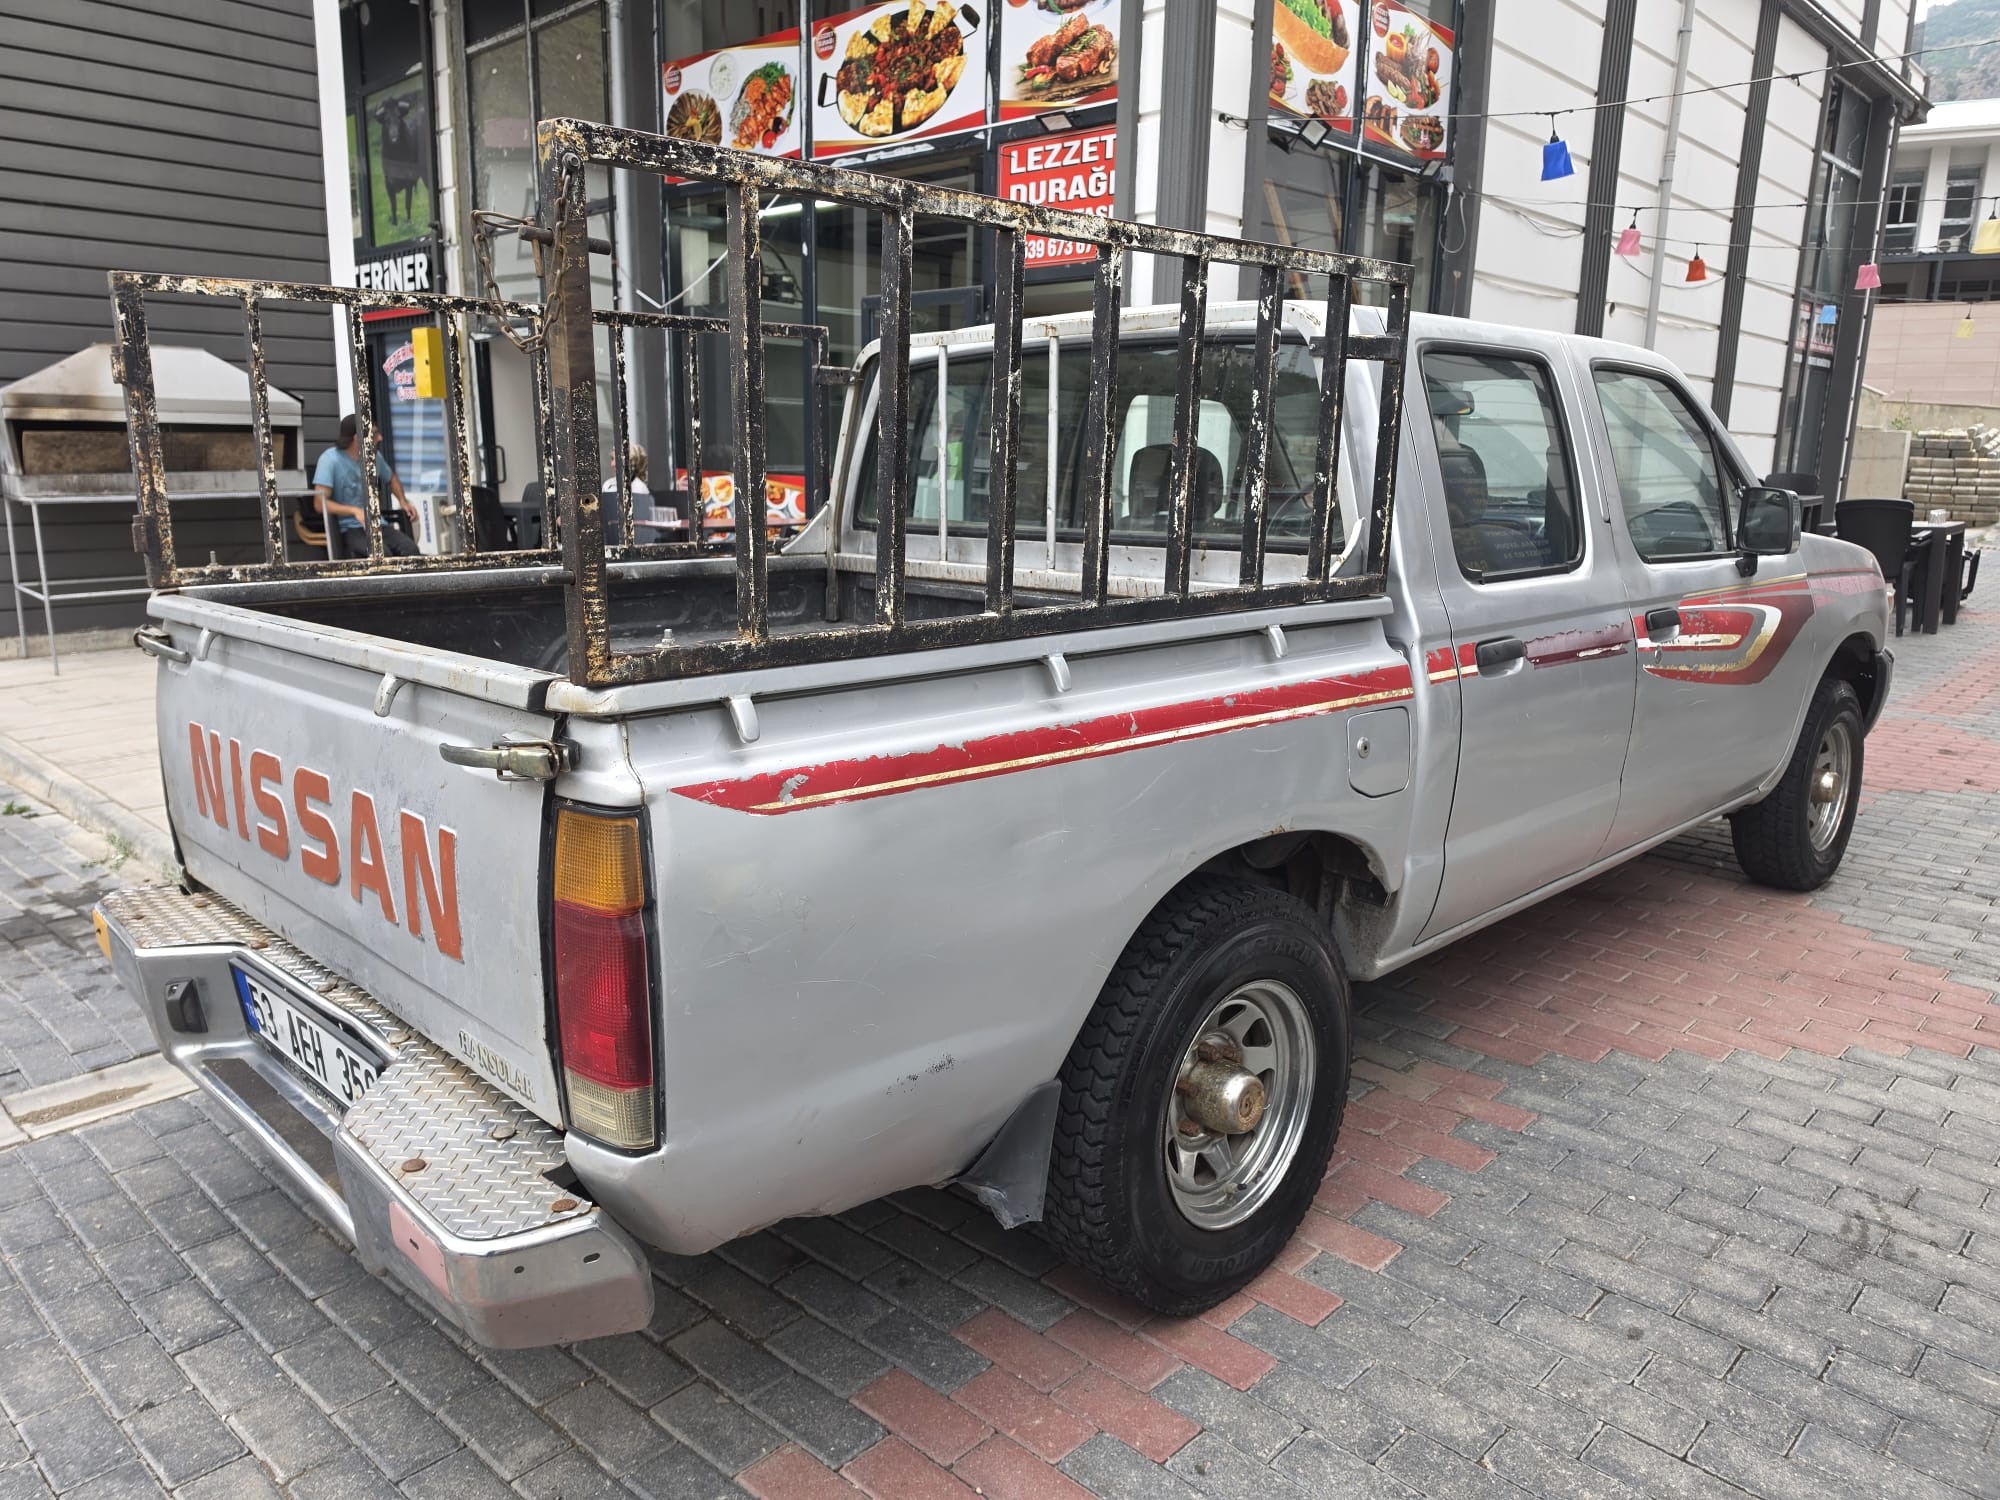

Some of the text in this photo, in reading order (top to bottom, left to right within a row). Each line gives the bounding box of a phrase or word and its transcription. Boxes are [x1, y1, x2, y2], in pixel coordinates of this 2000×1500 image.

[1010, 133, 1117, 175] LEZZET
[1047, 238, 1073, 257] 673
[189, 720, 465, 964] NISSAN
[248, 983, 278, 1041] 53
[287, 1009, 328, 1083] AEH
